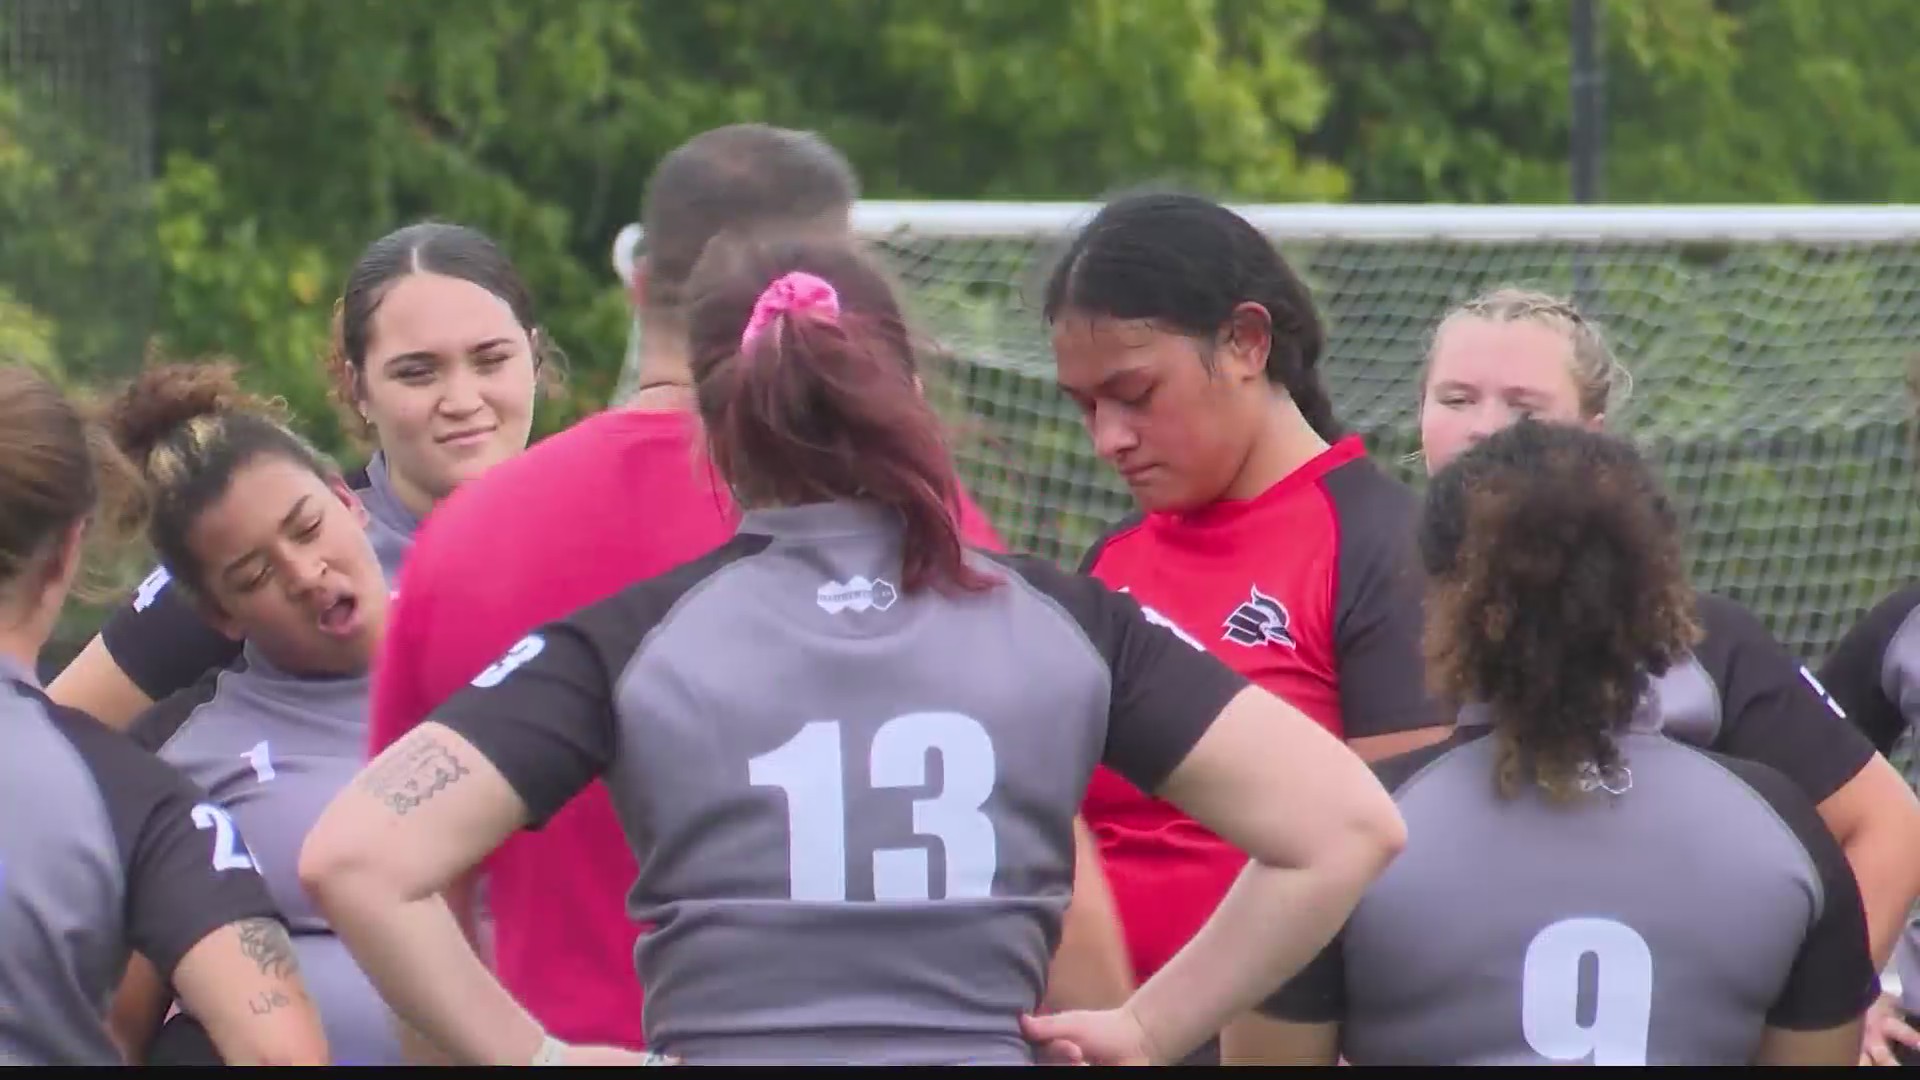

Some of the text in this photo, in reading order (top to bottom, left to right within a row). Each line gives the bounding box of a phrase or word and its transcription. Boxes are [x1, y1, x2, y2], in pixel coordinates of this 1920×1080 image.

[240, 740, 275, 783] 1
[748, 711, 996, 900] 13
[1522, 917, 1652, 1066] 9
